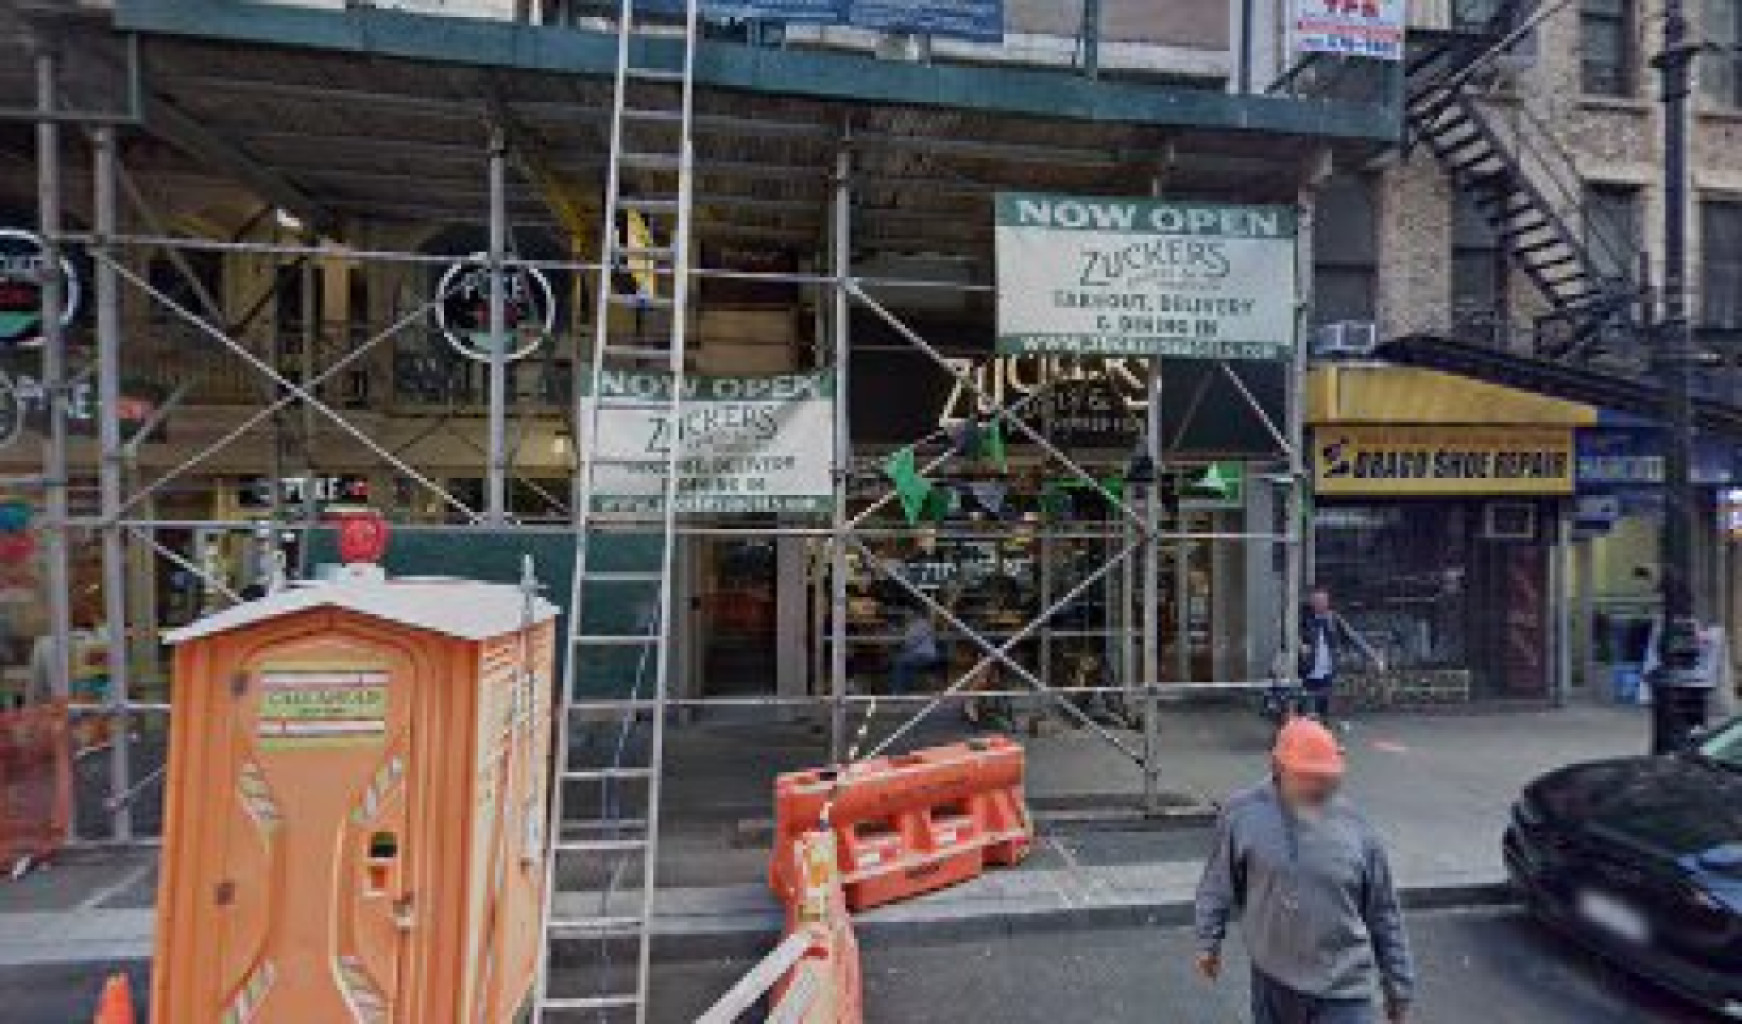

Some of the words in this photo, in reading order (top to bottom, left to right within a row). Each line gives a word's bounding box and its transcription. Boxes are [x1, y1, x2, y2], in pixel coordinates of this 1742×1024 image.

[1018, 200, 1137, 231] NOW
[1150, 205, 1278, 237] OPEN
[600, 371, 698, 396] NOW
[712, 373, 820, 399] OPEN
[1434, 450, 1491, 480] SHOE
[1494, 450, 1569, 480] REPAIR
